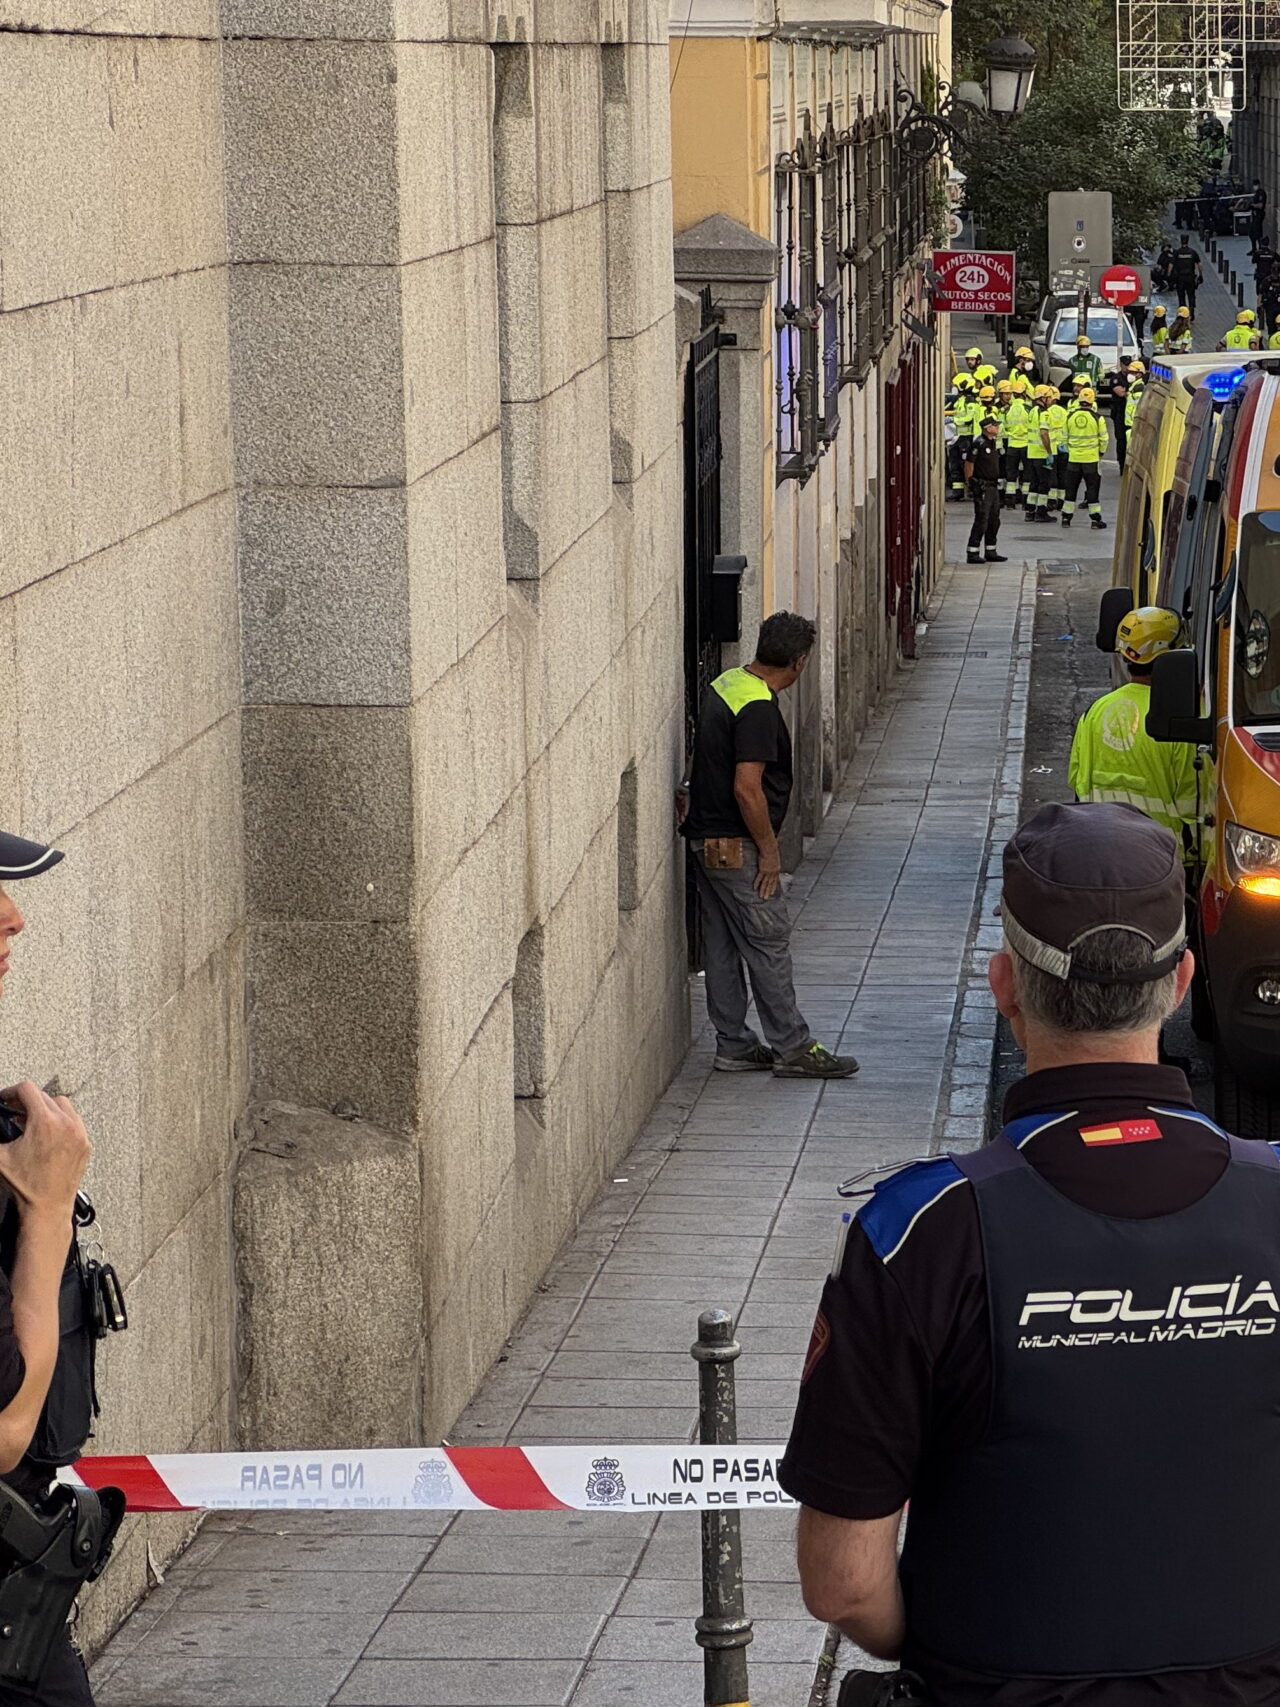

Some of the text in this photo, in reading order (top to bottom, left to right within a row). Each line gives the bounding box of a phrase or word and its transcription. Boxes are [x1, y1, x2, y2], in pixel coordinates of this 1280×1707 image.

[959, 270, 985, 284] 24h
[977, 291, 1011, 301] SECOS
[950, 301, 996, 311] BEBIDAS
[1018, 1275, 1280, 1326] POLICÍA
[1017, 1317, 1277, 1349] MUNICIPAL MADRID
[673, 1458, 704, 1484] NO
[631, 1490, 799, 1505] LINEA DE POL
